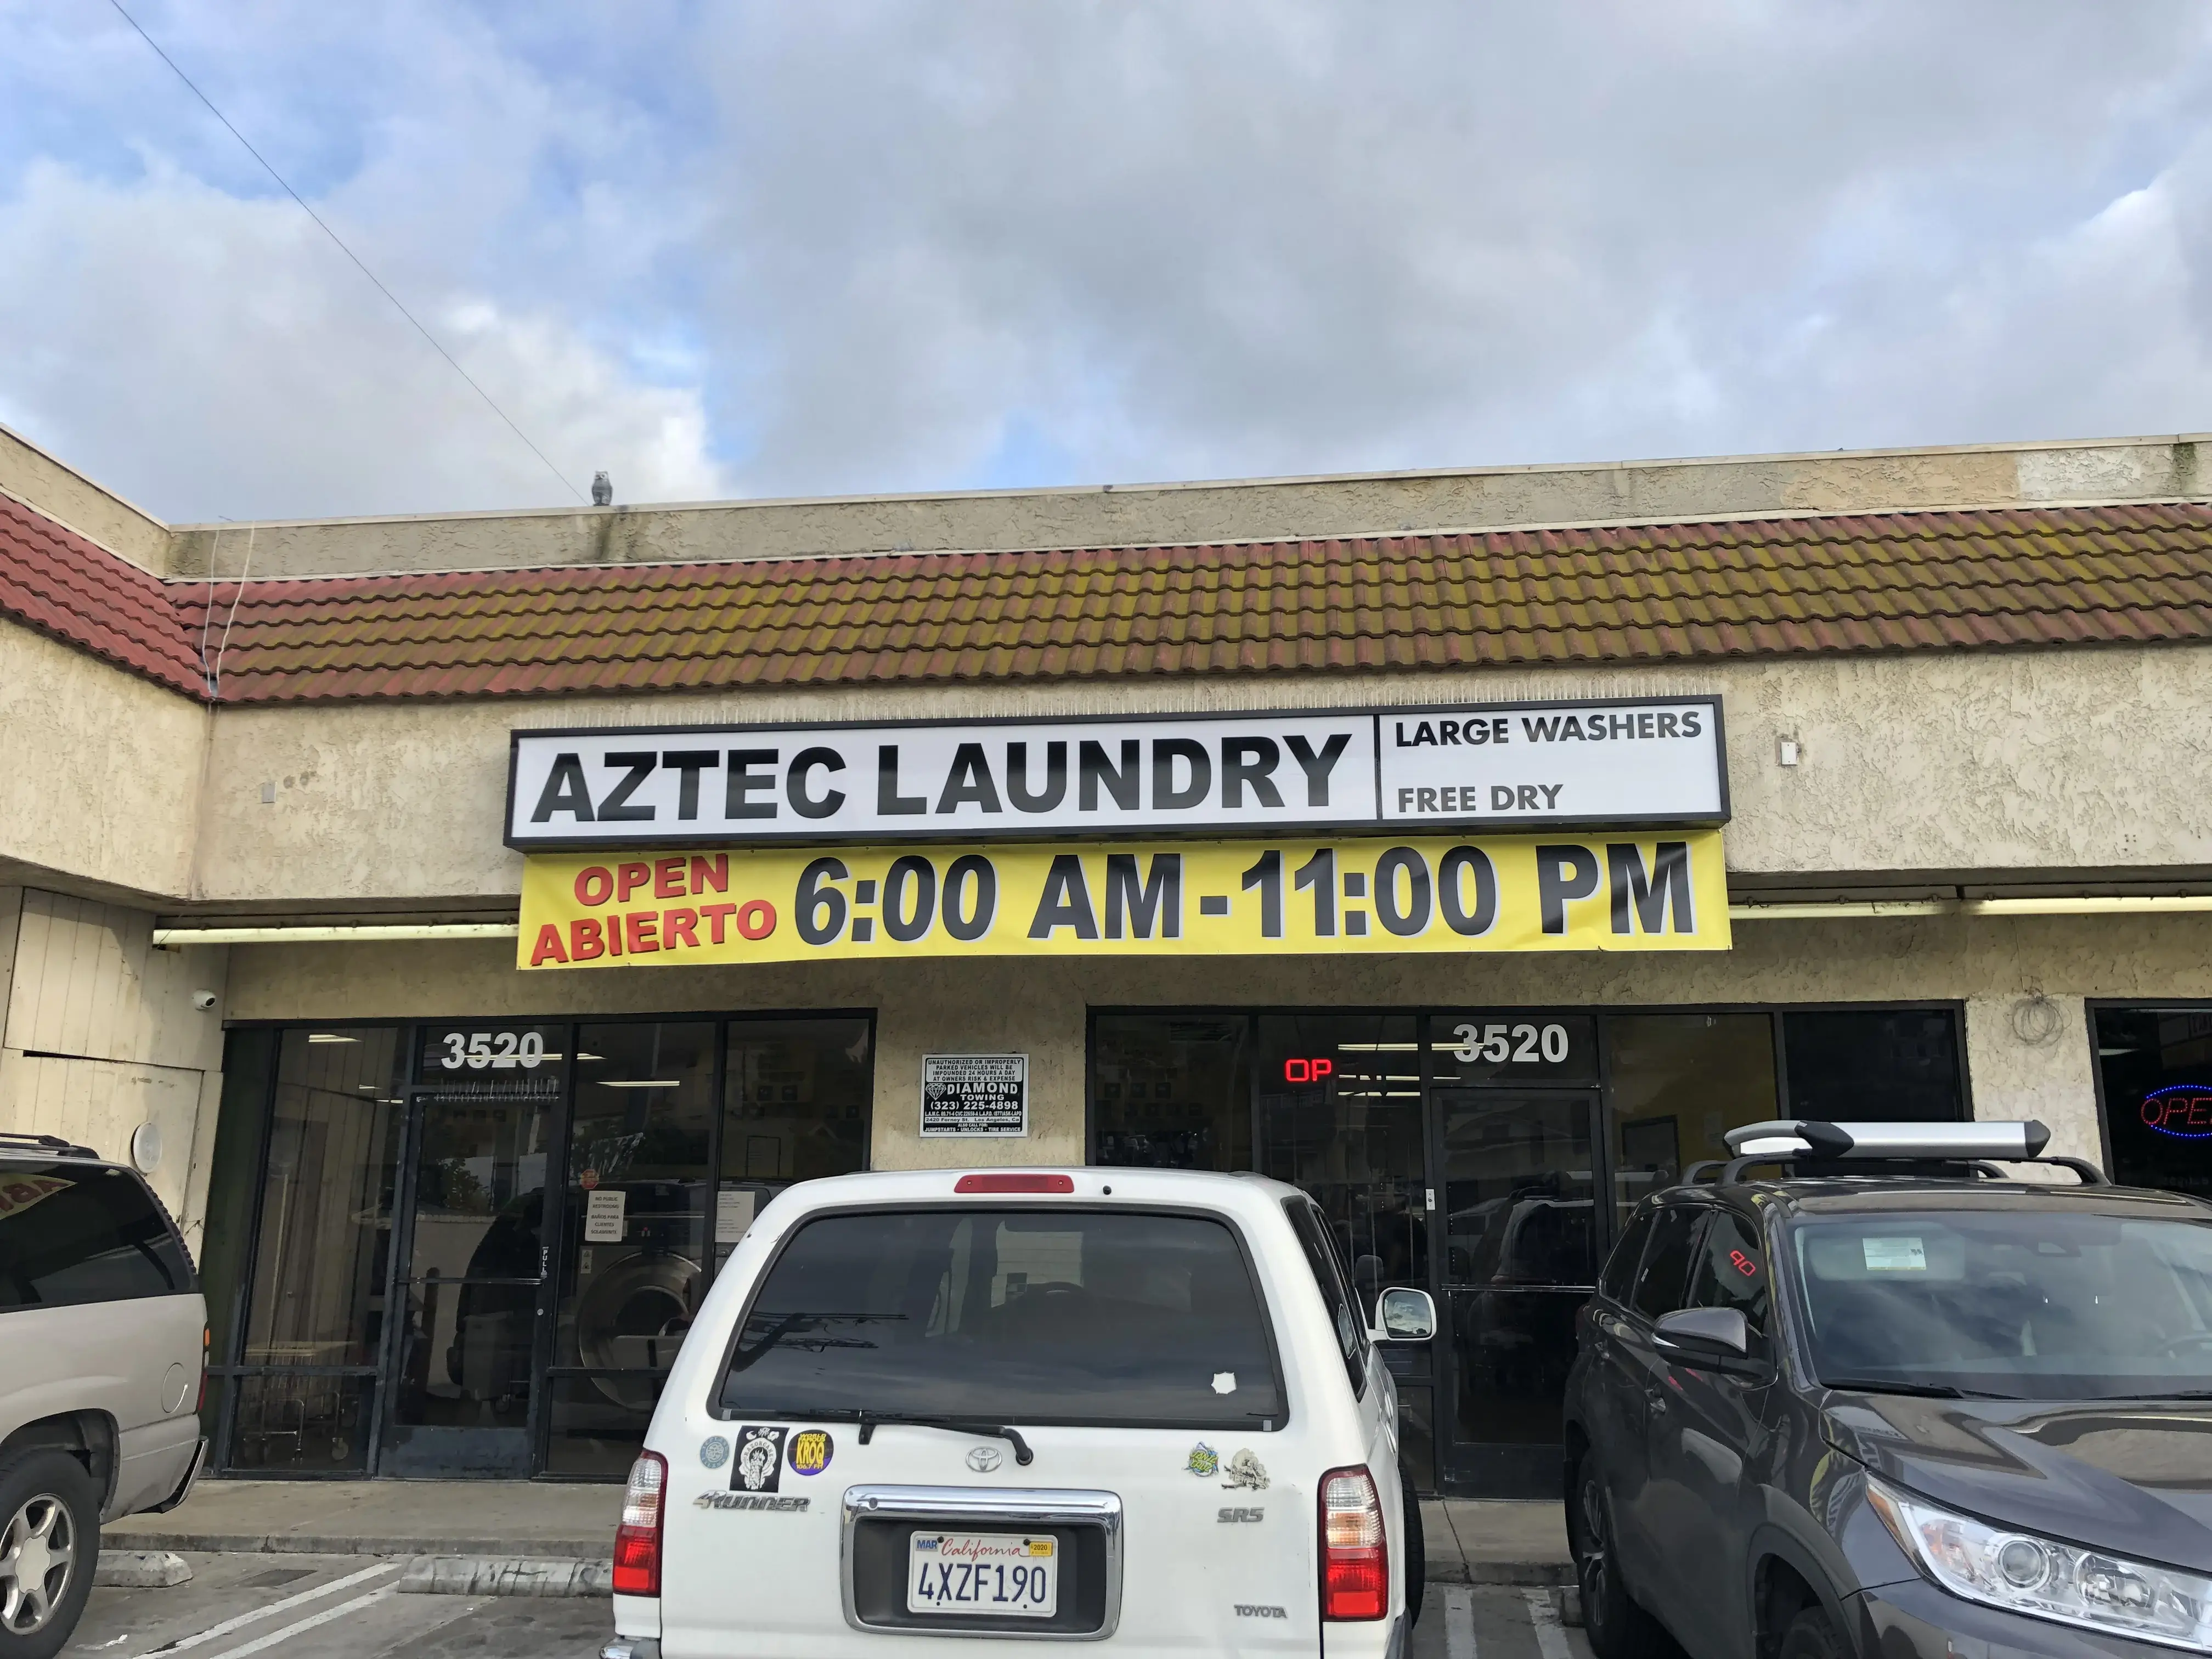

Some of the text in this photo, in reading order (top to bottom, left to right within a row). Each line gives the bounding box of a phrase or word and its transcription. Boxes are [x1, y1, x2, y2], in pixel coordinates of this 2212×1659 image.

[1396, 712, 1701, 747] LARGE WASHERS
[531, 734, 1352, 822] AZTEC LAUNDRY
[1398, 784, 1564, 812] FREE DRY
[574, 853, 729, 906] OPEN
[795, 854, 997, 947] 6:00
[1536, 842, 1696, 935] PM
[530, 900, 777, 966] ABIERTO
[441, 1032, 544, 1069] 3520
[1453, 1024, 1568, 1063] 3520
[947, 1082, 1018, 1094] DIAMOND
[930, 1101, 1018, 1110] (323) 225-4898
[2141, 1098, 2212, 1125] OPE
[796, 1441, 825, 1467] KROQ
[1217, 1506, 1265, 1523] SR5
[917, 1539, 938, 1549] MAR
[941, 1538, 1025, 1562] California
[918, 1563, 1046, 1603] 4XZF190
[1234, 1604, 1288, 1618] TOYOTA
